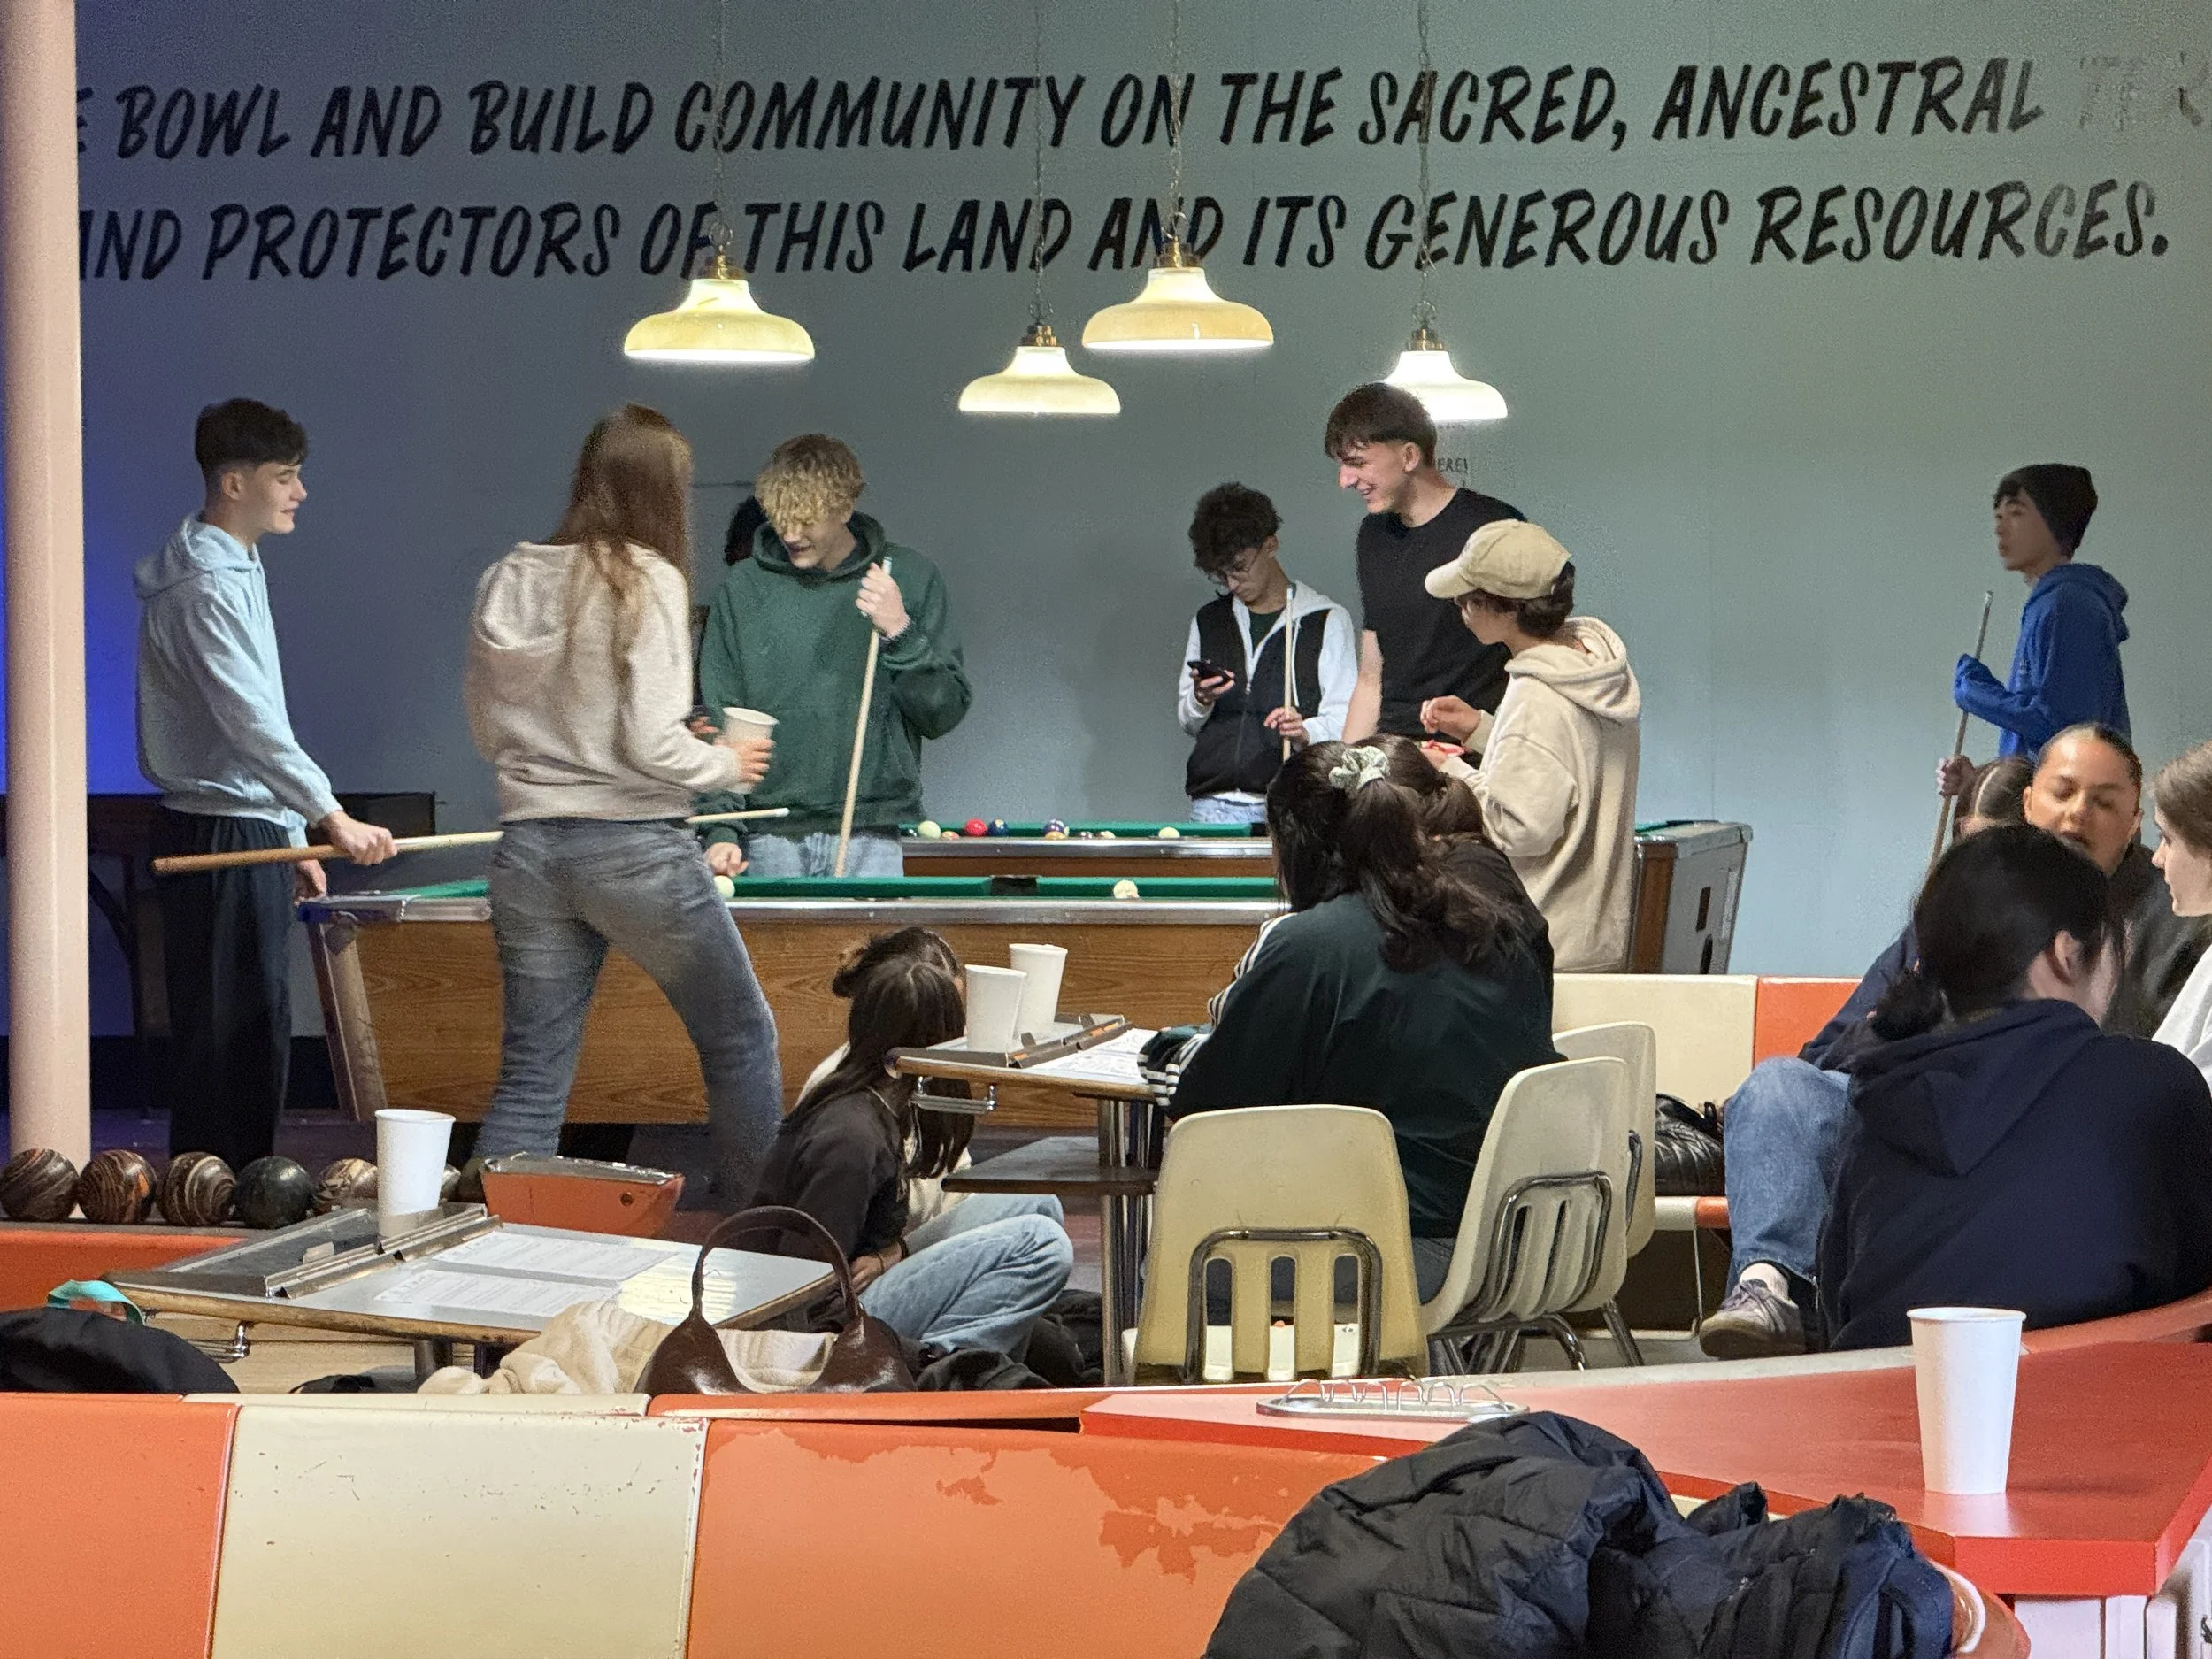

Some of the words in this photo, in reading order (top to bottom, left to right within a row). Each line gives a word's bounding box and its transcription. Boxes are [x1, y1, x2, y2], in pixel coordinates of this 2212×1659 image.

[115, 84, 290, 160] BOWL
[311, 86, 441, 157] AND
[469, 81, 654, 155] BUILD
[675, 74, 1086, 153] COMMUNITY
[1101, 73, 1195, 148] ON
[1219, 66, 1343, 147] THE
[1358, 64, 1627, 152] SACRED,
[1651, 56, 2044, 141] ANCESTRAL
[203, 202, 621, 280] PROTECTORS
[640, 201, 718, 280] OF
[744, 201, 885, 274] THIS
[902, 198, 1072, 273] LAND
[1087, 196, 1224, 272] AND
[1242, 195, 1347, 269] ITS
[1364, 188, 1730, 271] GENEROUS
[1750, 179, 2169, 265] RESOURCES.
